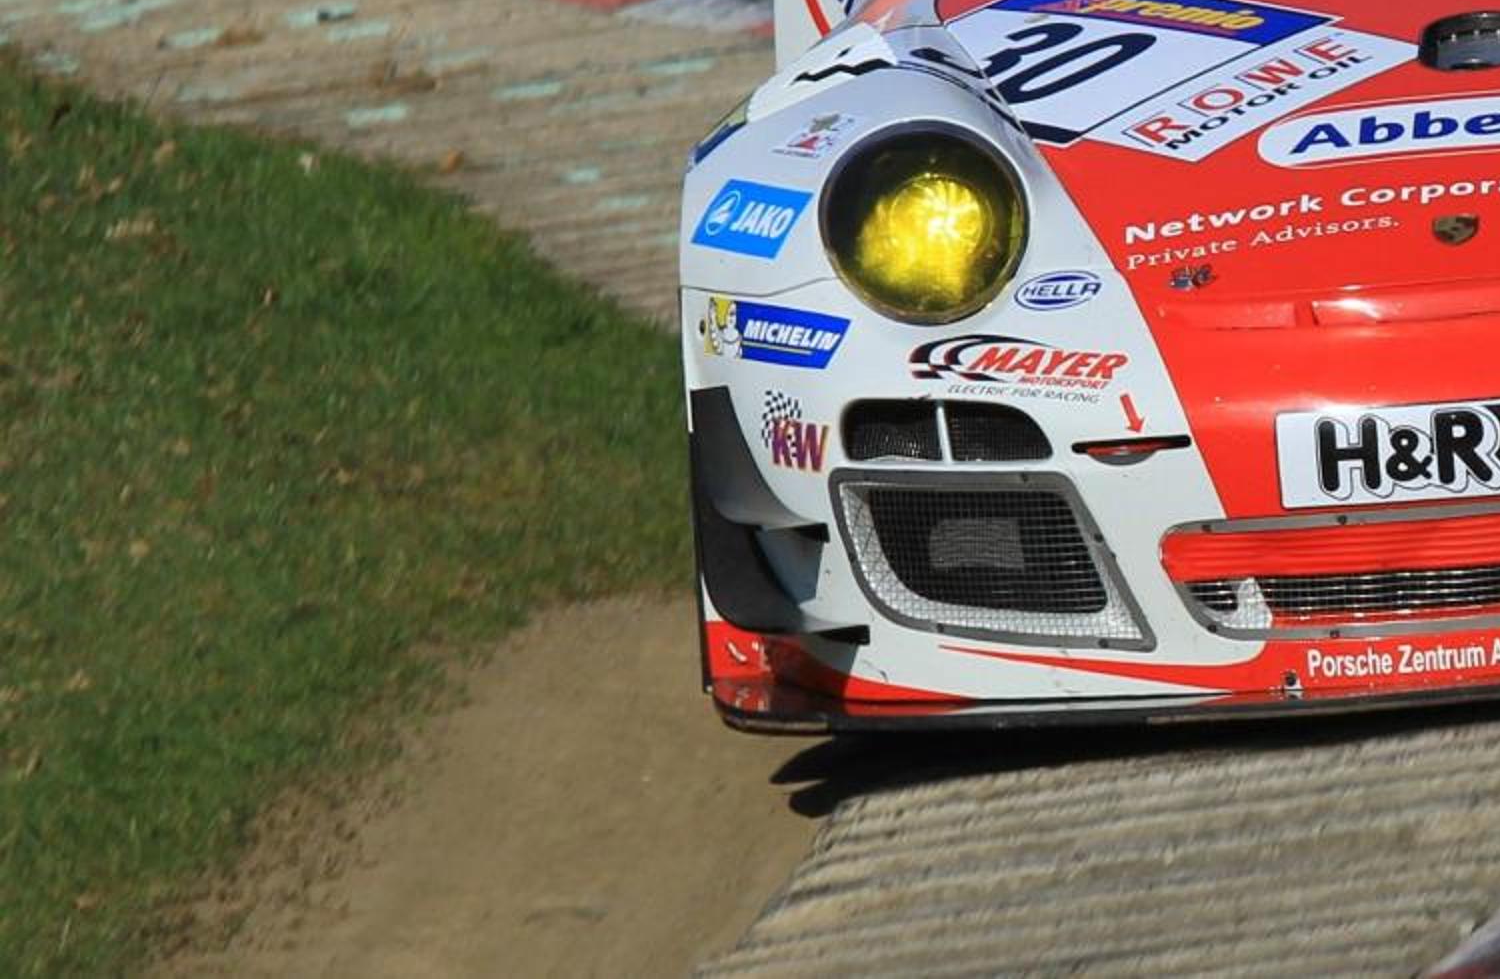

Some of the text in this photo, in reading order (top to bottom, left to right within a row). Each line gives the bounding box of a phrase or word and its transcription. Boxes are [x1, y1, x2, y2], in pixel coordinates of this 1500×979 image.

[1130, 39, 1357, 144] ROWE
[1164, 56, 1372, 149] MOTOR OIL
[731, 201, 795, 239] JAKO
[1125, 195, 1323, 244] Network
[1126, 215, 1400, 270] Private Advisors.
[1022, 282, 1102, 298] HELLA
[744, 319, 841, 351] MICHELIN
[967, 347, 1128, 379] MAYER
[948, 384, 1008, 397] ELECTRIC
[1044, 389, 1100, 404] RACING
[1016, 376, 1110, 390] MOTORSPORT
[773, 418, 829, 471] KW
[1308, 649, 1393, 677] Porsche
[1397, 643, 1486, 672] Zentrum
